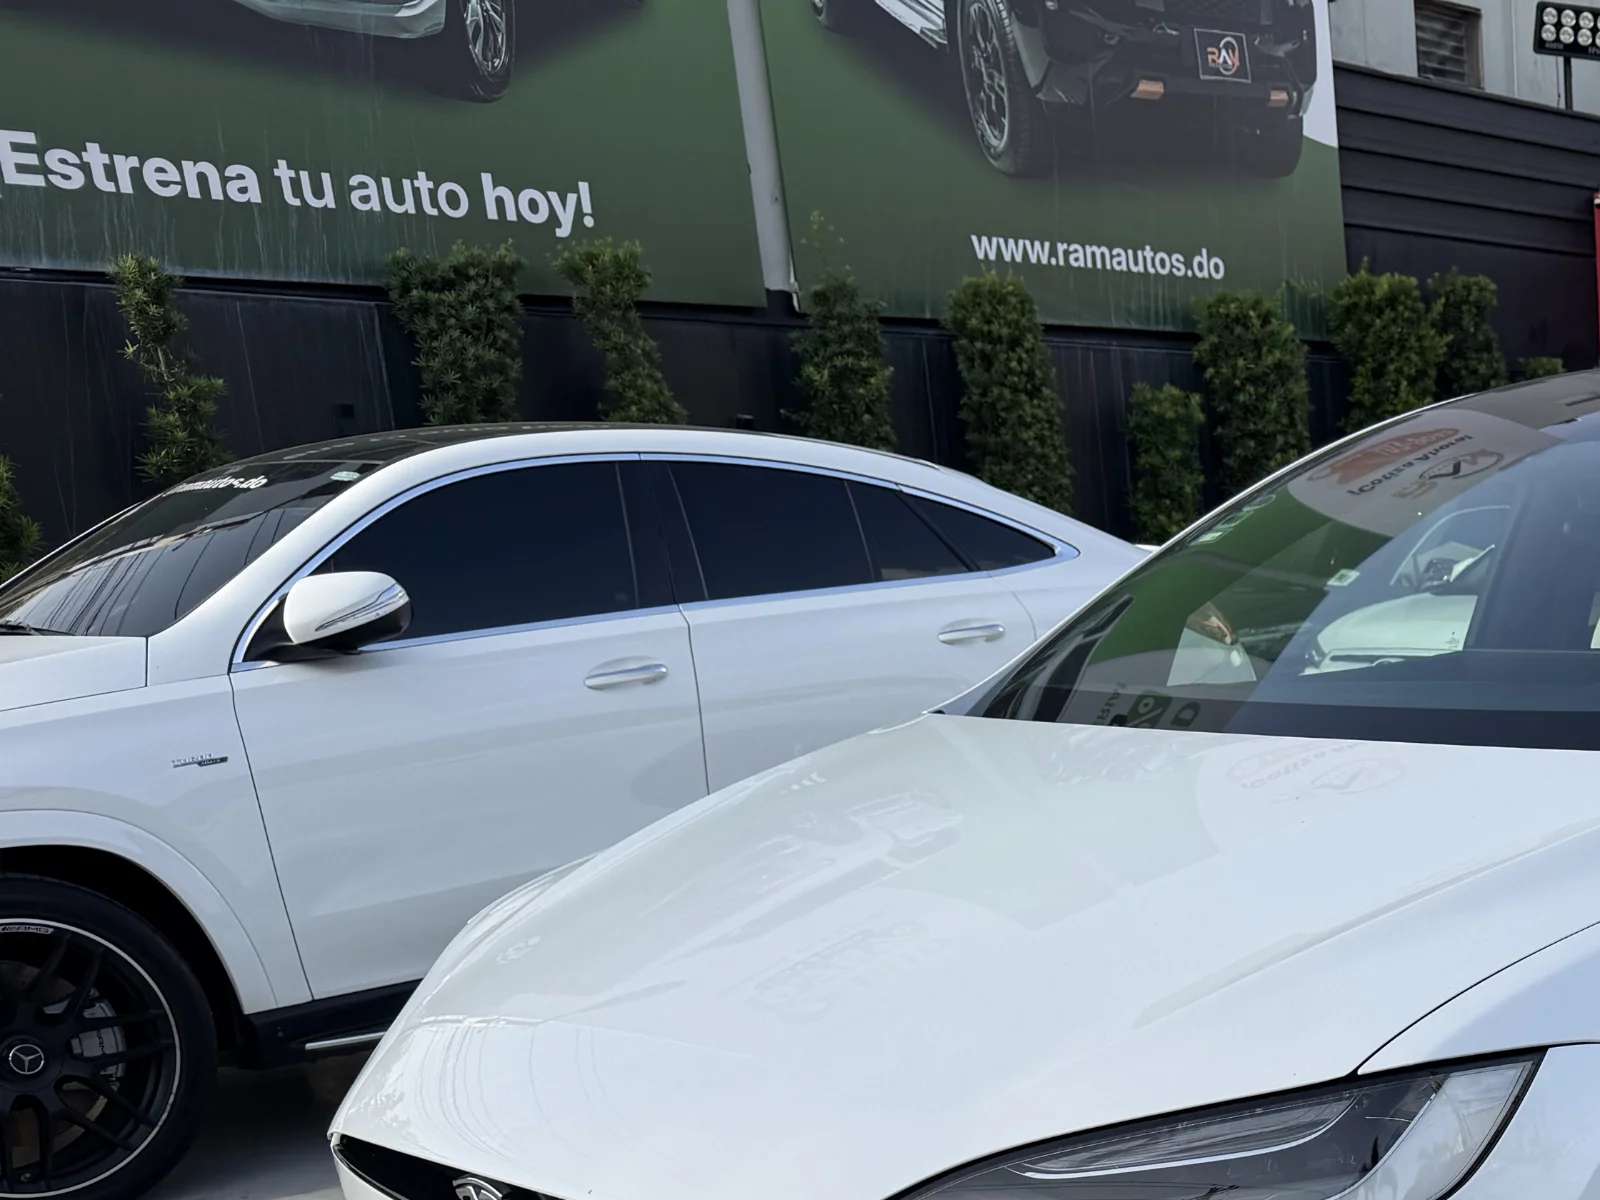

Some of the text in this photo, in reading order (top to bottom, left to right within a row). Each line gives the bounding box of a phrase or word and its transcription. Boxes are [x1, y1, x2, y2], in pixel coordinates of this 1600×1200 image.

[0, 129, 595, 238] Estrena tu auto hoy!
[970, 234, 1225, 280] www.ramautos.do
